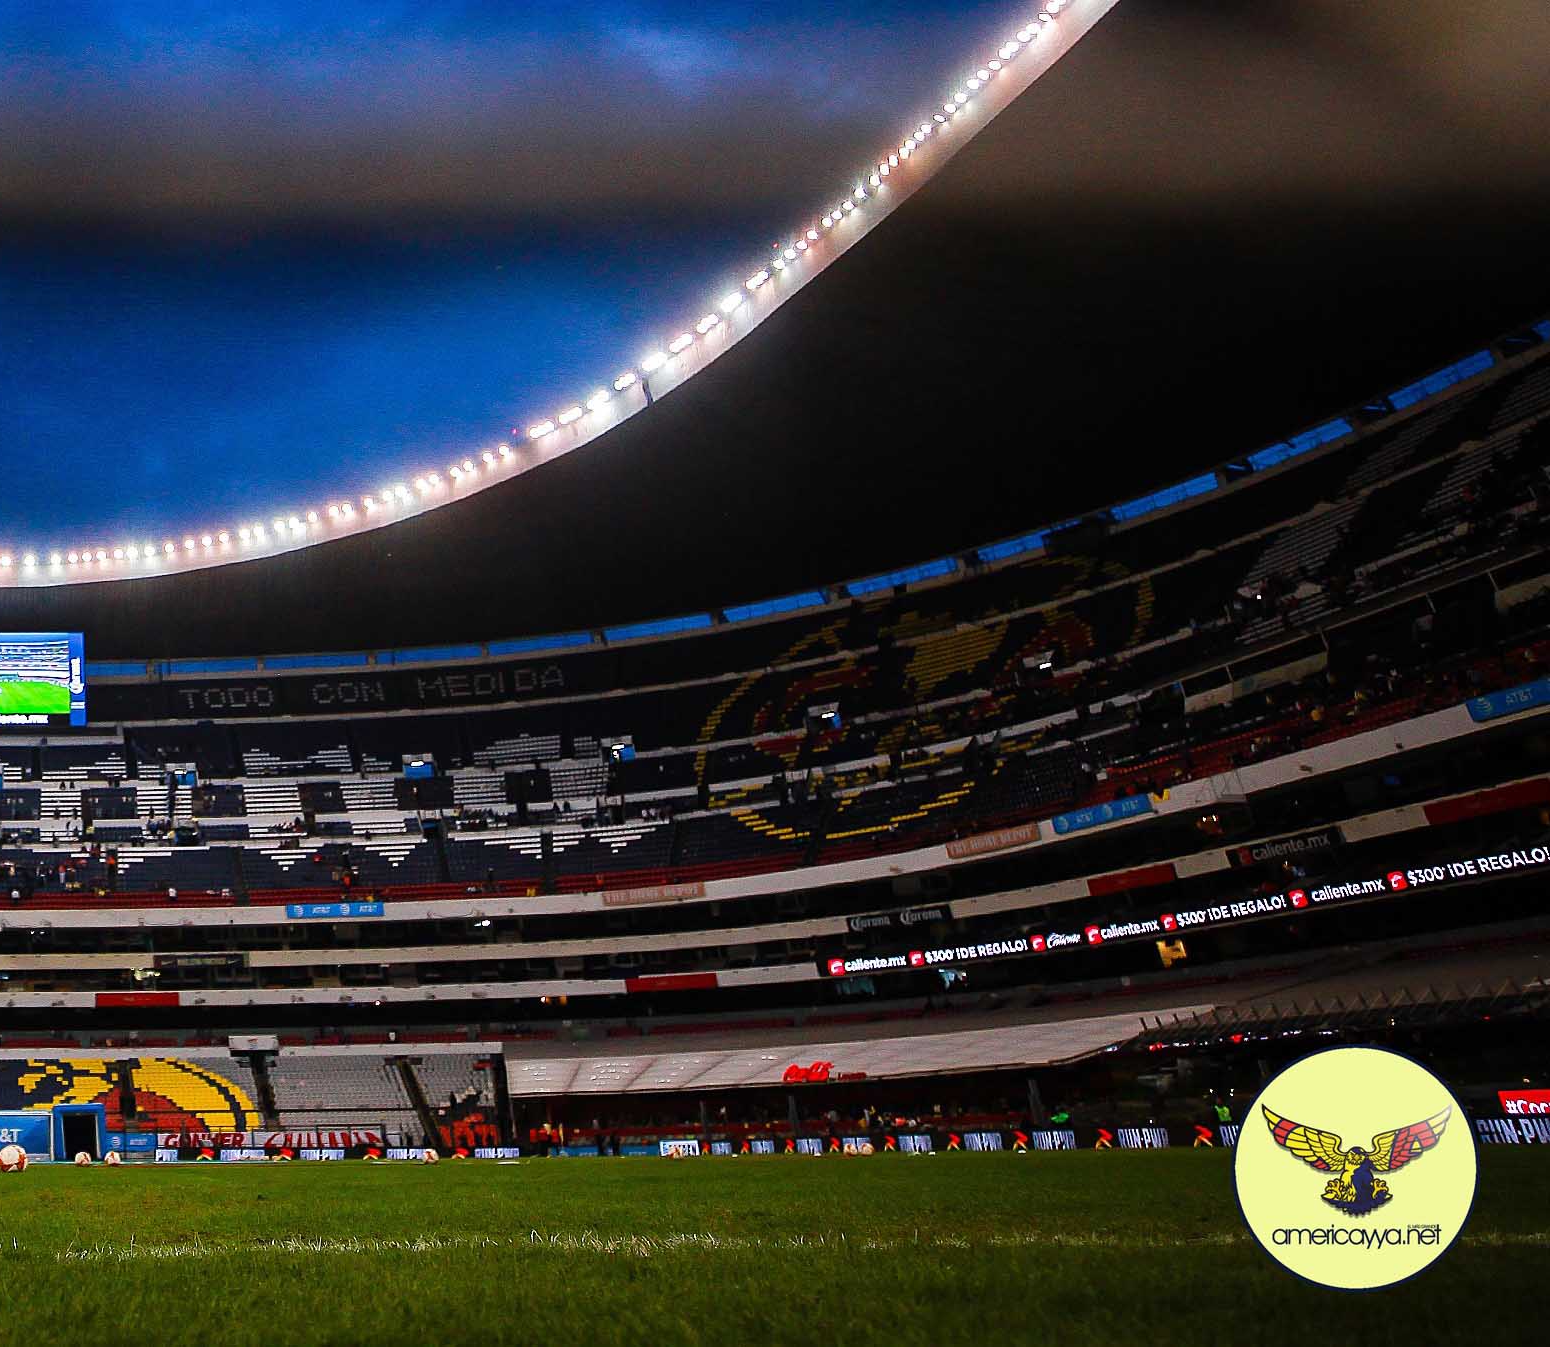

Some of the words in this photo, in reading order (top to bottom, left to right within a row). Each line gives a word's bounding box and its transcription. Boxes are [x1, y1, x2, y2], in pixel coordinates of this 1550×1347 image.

[179, 687, 274, 709] TODO
[312, 681, 384, 704] CON
[417, 665, 564, 699] MEDIDA
[1252, 833, 1330, 861] caliente.mx
[844, 956, 906, 972] caliente.mx
[977, 939, 1028, 958] REGALO!
[1100, 919, 1160, 940] caliente.mx
[1230, 895, 1288, 918] REGALO!
[1311, 878, 1386, 902] caliente.mx
[1477, 846, 1550, 873] REGALO!
[850, 915, 891, 932] Corona
[900, 907, 942, 925] Corona
